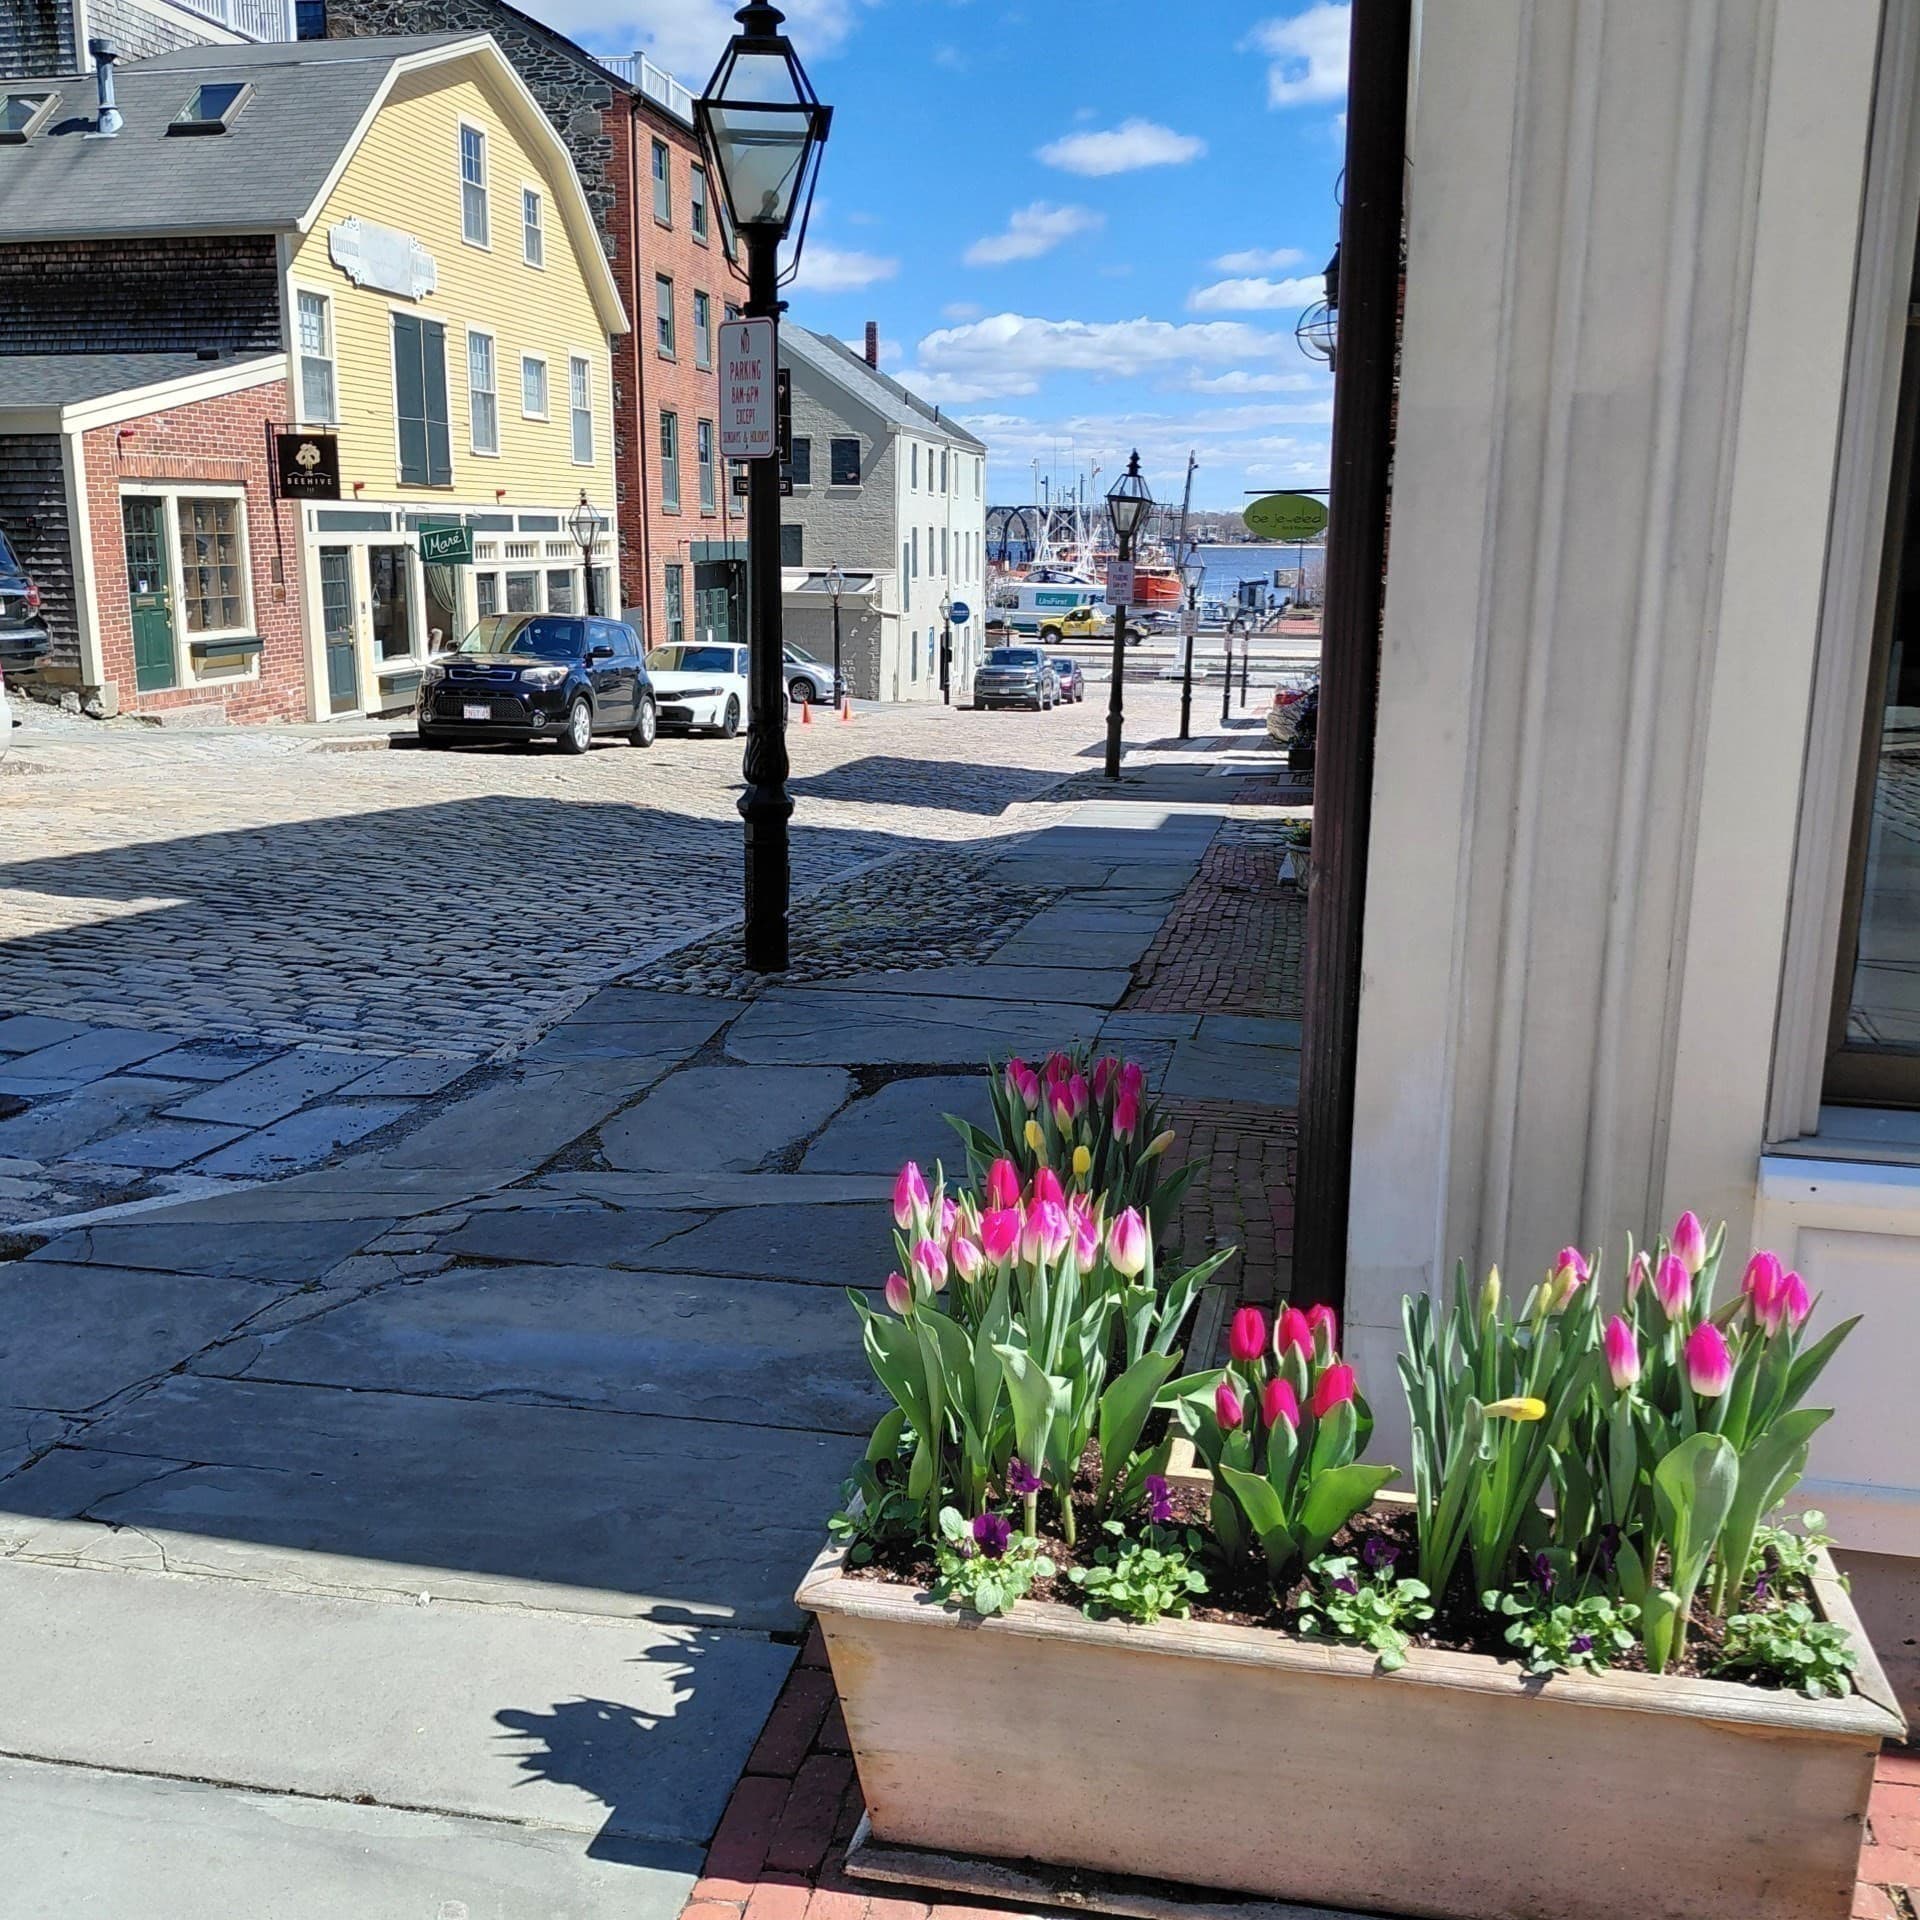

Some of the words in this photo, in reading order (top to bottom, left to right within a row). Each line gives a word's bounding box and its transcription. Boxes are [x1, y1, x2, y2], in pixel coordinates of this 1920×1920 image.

[741, 334, 750, 354] NO
[730, 360, 761, 381] PARKING
[731, 386, 759, 404] 8AM-6PM
[736, 408, 756, 425] EXCEPT
[287, 477, 333, 485] BEEHIVE
[430, 531, 462, 555] Maré
